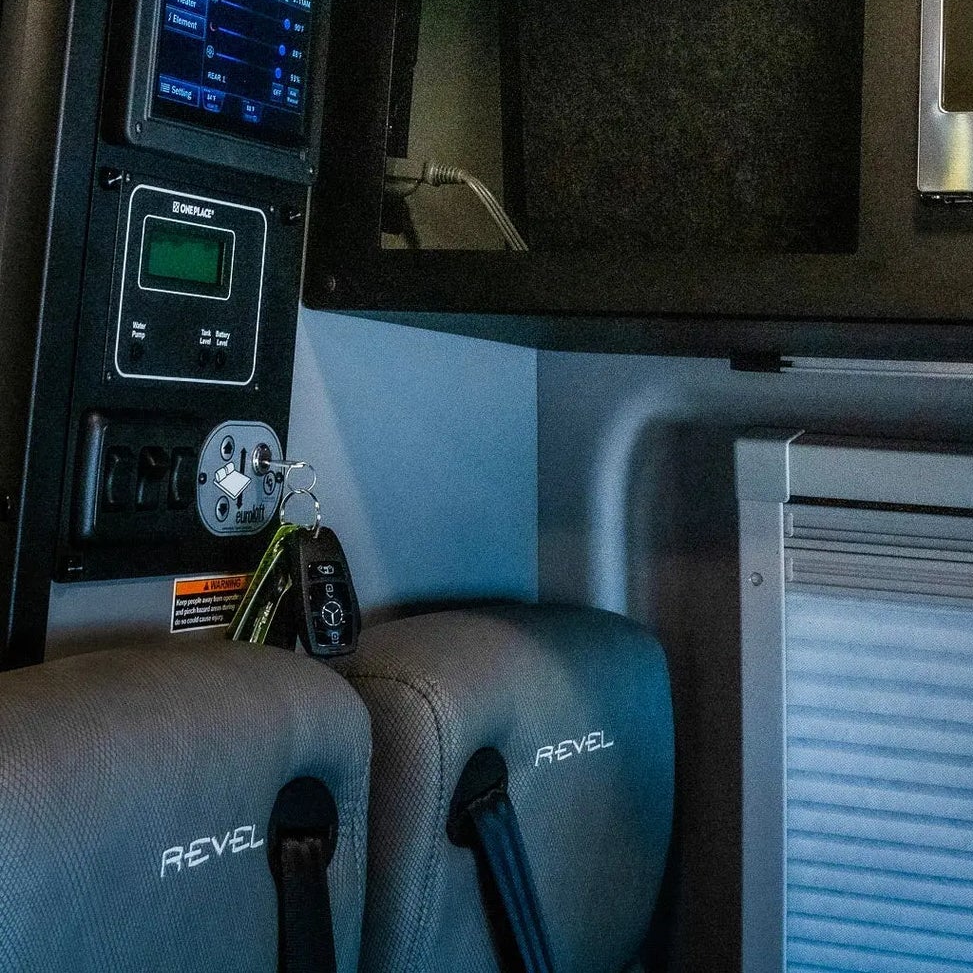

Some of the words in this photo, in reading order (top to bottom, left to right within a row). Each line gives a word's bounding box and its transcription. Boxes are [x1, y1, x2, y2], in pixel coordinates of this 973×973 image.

[173, 14, 197, 29] Element
[171, 85, 192, 100] Setting
[133, 321, 146, 329] Water
[132, 330, 145, 340] Pump
[236, 504, 265, 524] euroloft
[210, 578, 241, 590] WARNING
[188, 598, 201, 606] people
[534, 730, 614, 767] REVEL
[160, 824, 264, 877] REVEL
